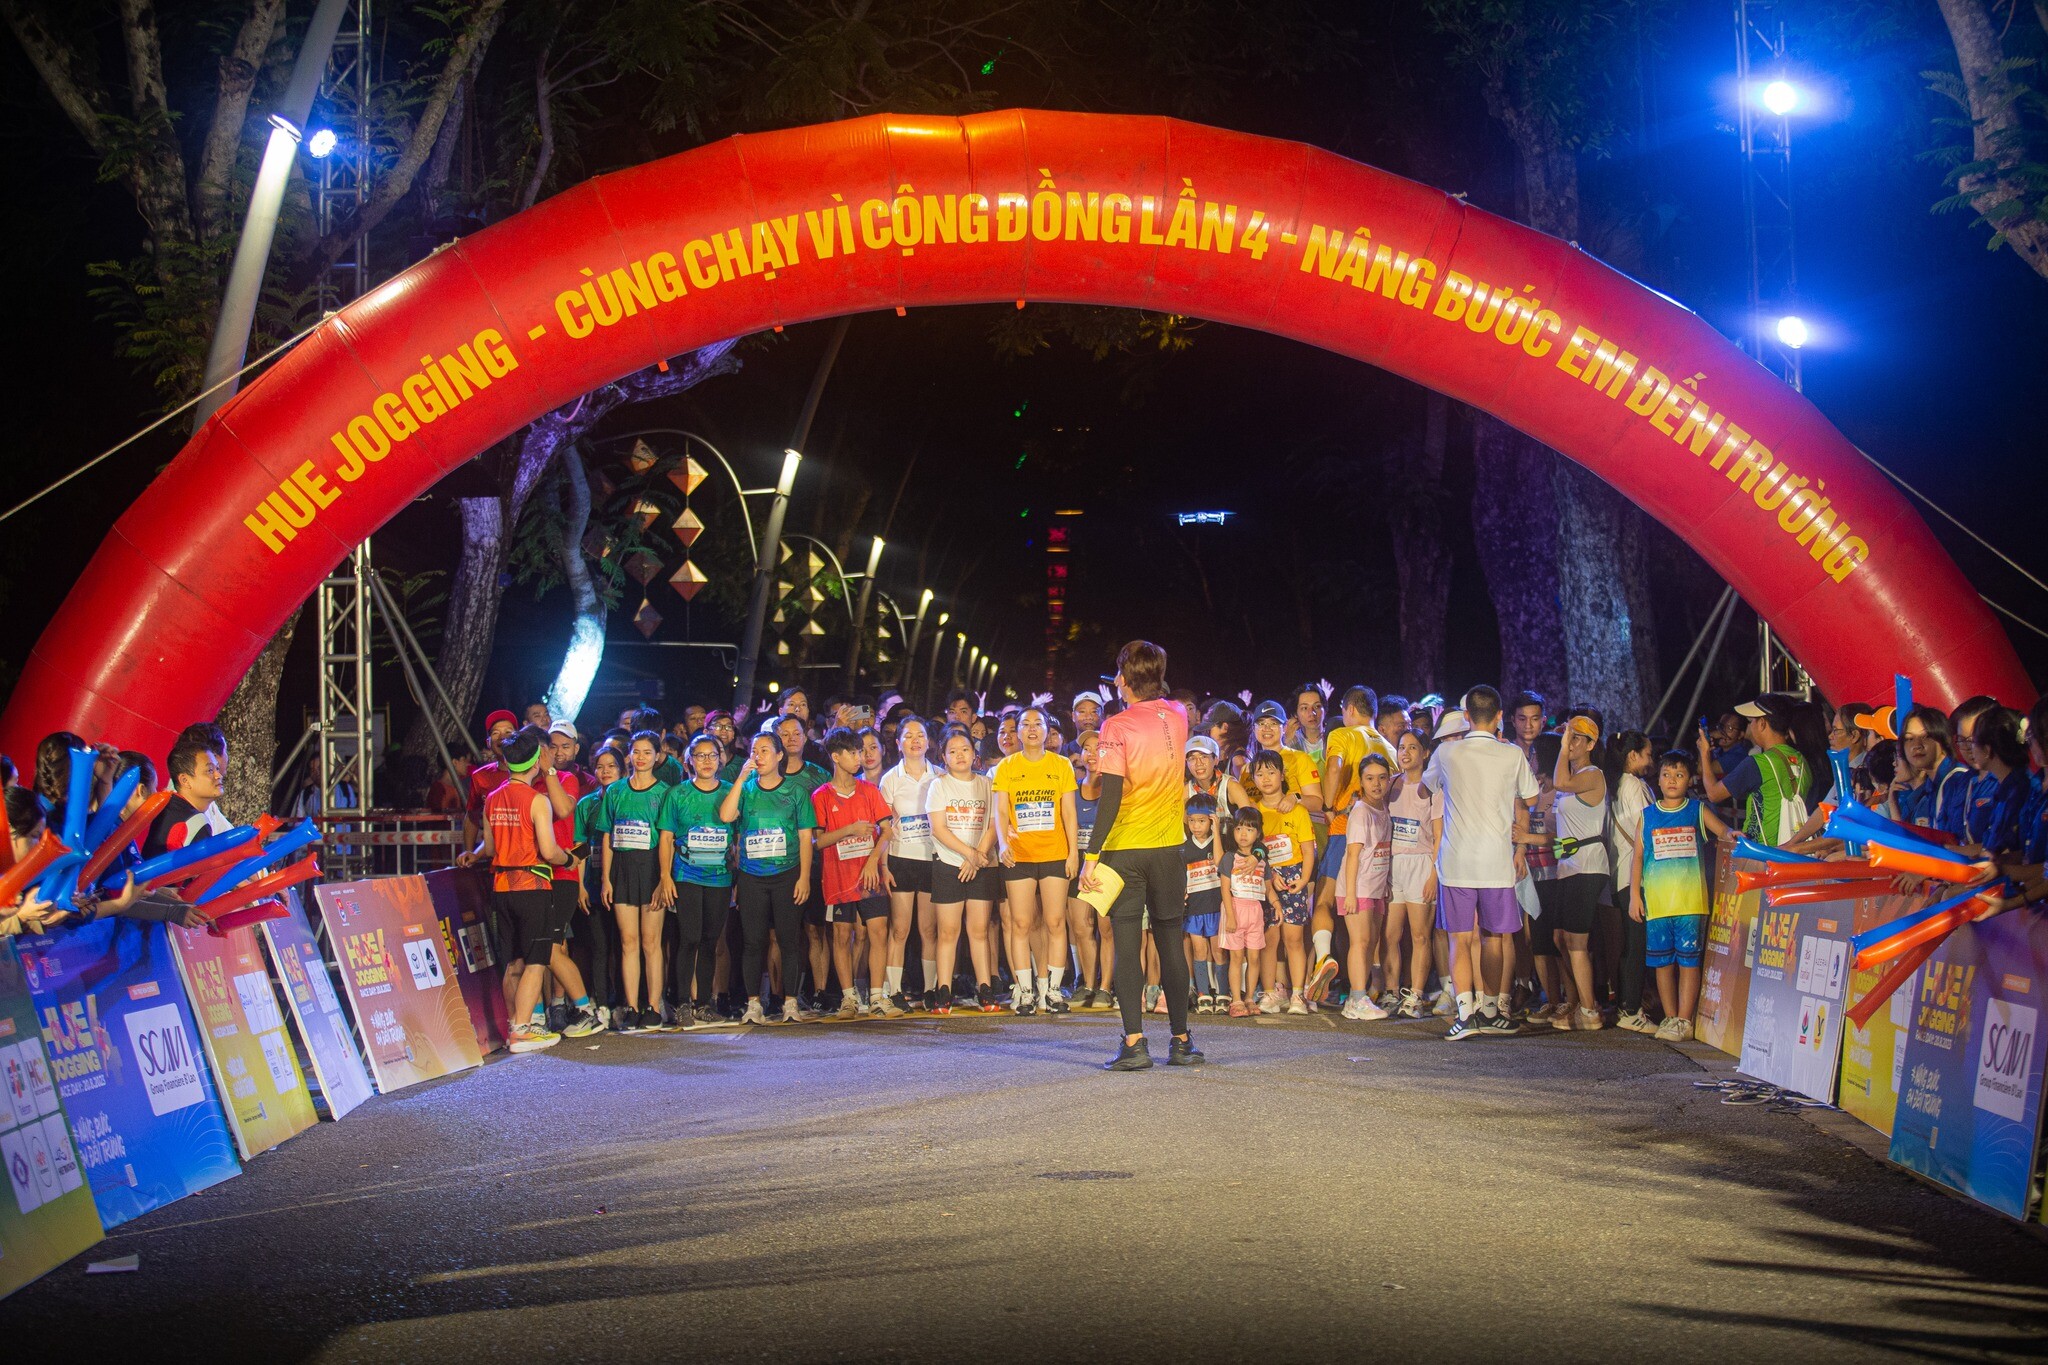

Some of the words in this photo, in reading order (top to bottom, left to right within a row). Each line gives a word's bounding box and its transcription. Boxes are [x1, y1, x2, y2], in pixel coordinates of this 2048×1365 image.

[243, 459, 342, 555] HUE
[555, 252, 688, 339] CÙNG
[682, 214, 800, 289] CHẠY
[805, 193, 856, 260] VÌ
[859, 183, 988, 256] CỘNG
[996, 168, 1132, 244] ĐỒNG
[1139, 177, 1238, 255] LẦN
[1240, 210, 1270, 260] 4
[1299, 224, 1437, 310] NÂNG
[1432, 269, 1562, 358] BƯỚC
[1556, 325, 1639, 400] EM
[1624, 366, 1725, 457] ĐẾN
[1709, 422, 1869, 584] TRƯỜNG
[1016, 789, 1056, 797] AMAZING
[1017, 810, 1052, 819] 518521
[1655, 836, 1693, 845] 517150
[139, 1026, 189, 1077] SCAVI
[1983, 1023, 2031, 1079] SCAVI
[150, 1081, 166, 1096] Group
[1979, 1074, 1992, 1091] Group
[60, 1085, 73, 1098] ACE
